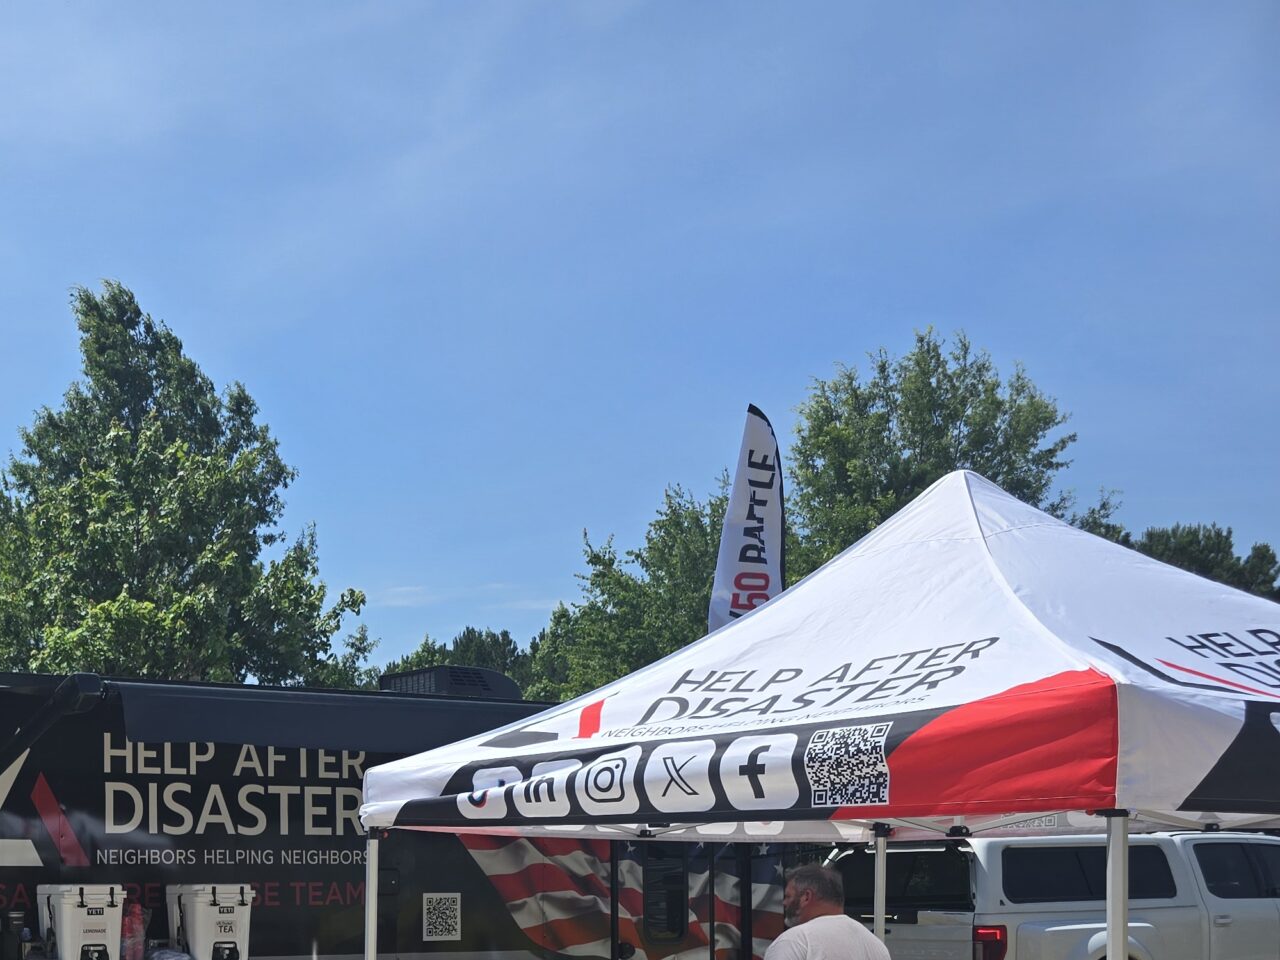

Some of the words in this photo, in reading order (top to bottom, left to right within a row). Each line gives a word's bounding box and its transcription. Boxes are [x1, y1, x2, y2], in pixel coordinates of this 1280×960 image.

[668, 668, 804, 694] HELP
[808, 636, 1000, 687] AFTER
[635, 665, 965, 726] DISASTER
[601, 724, 709, 738] NEIGHBORS
[103, 732, 215, 775] HELP
[105, 781, 367, 836] DISASTER
[96, 849, 196, 865] NEIGHBORS
[204, 849, 274, 865] HELPING
[218, 925, 233, 933] TEA
